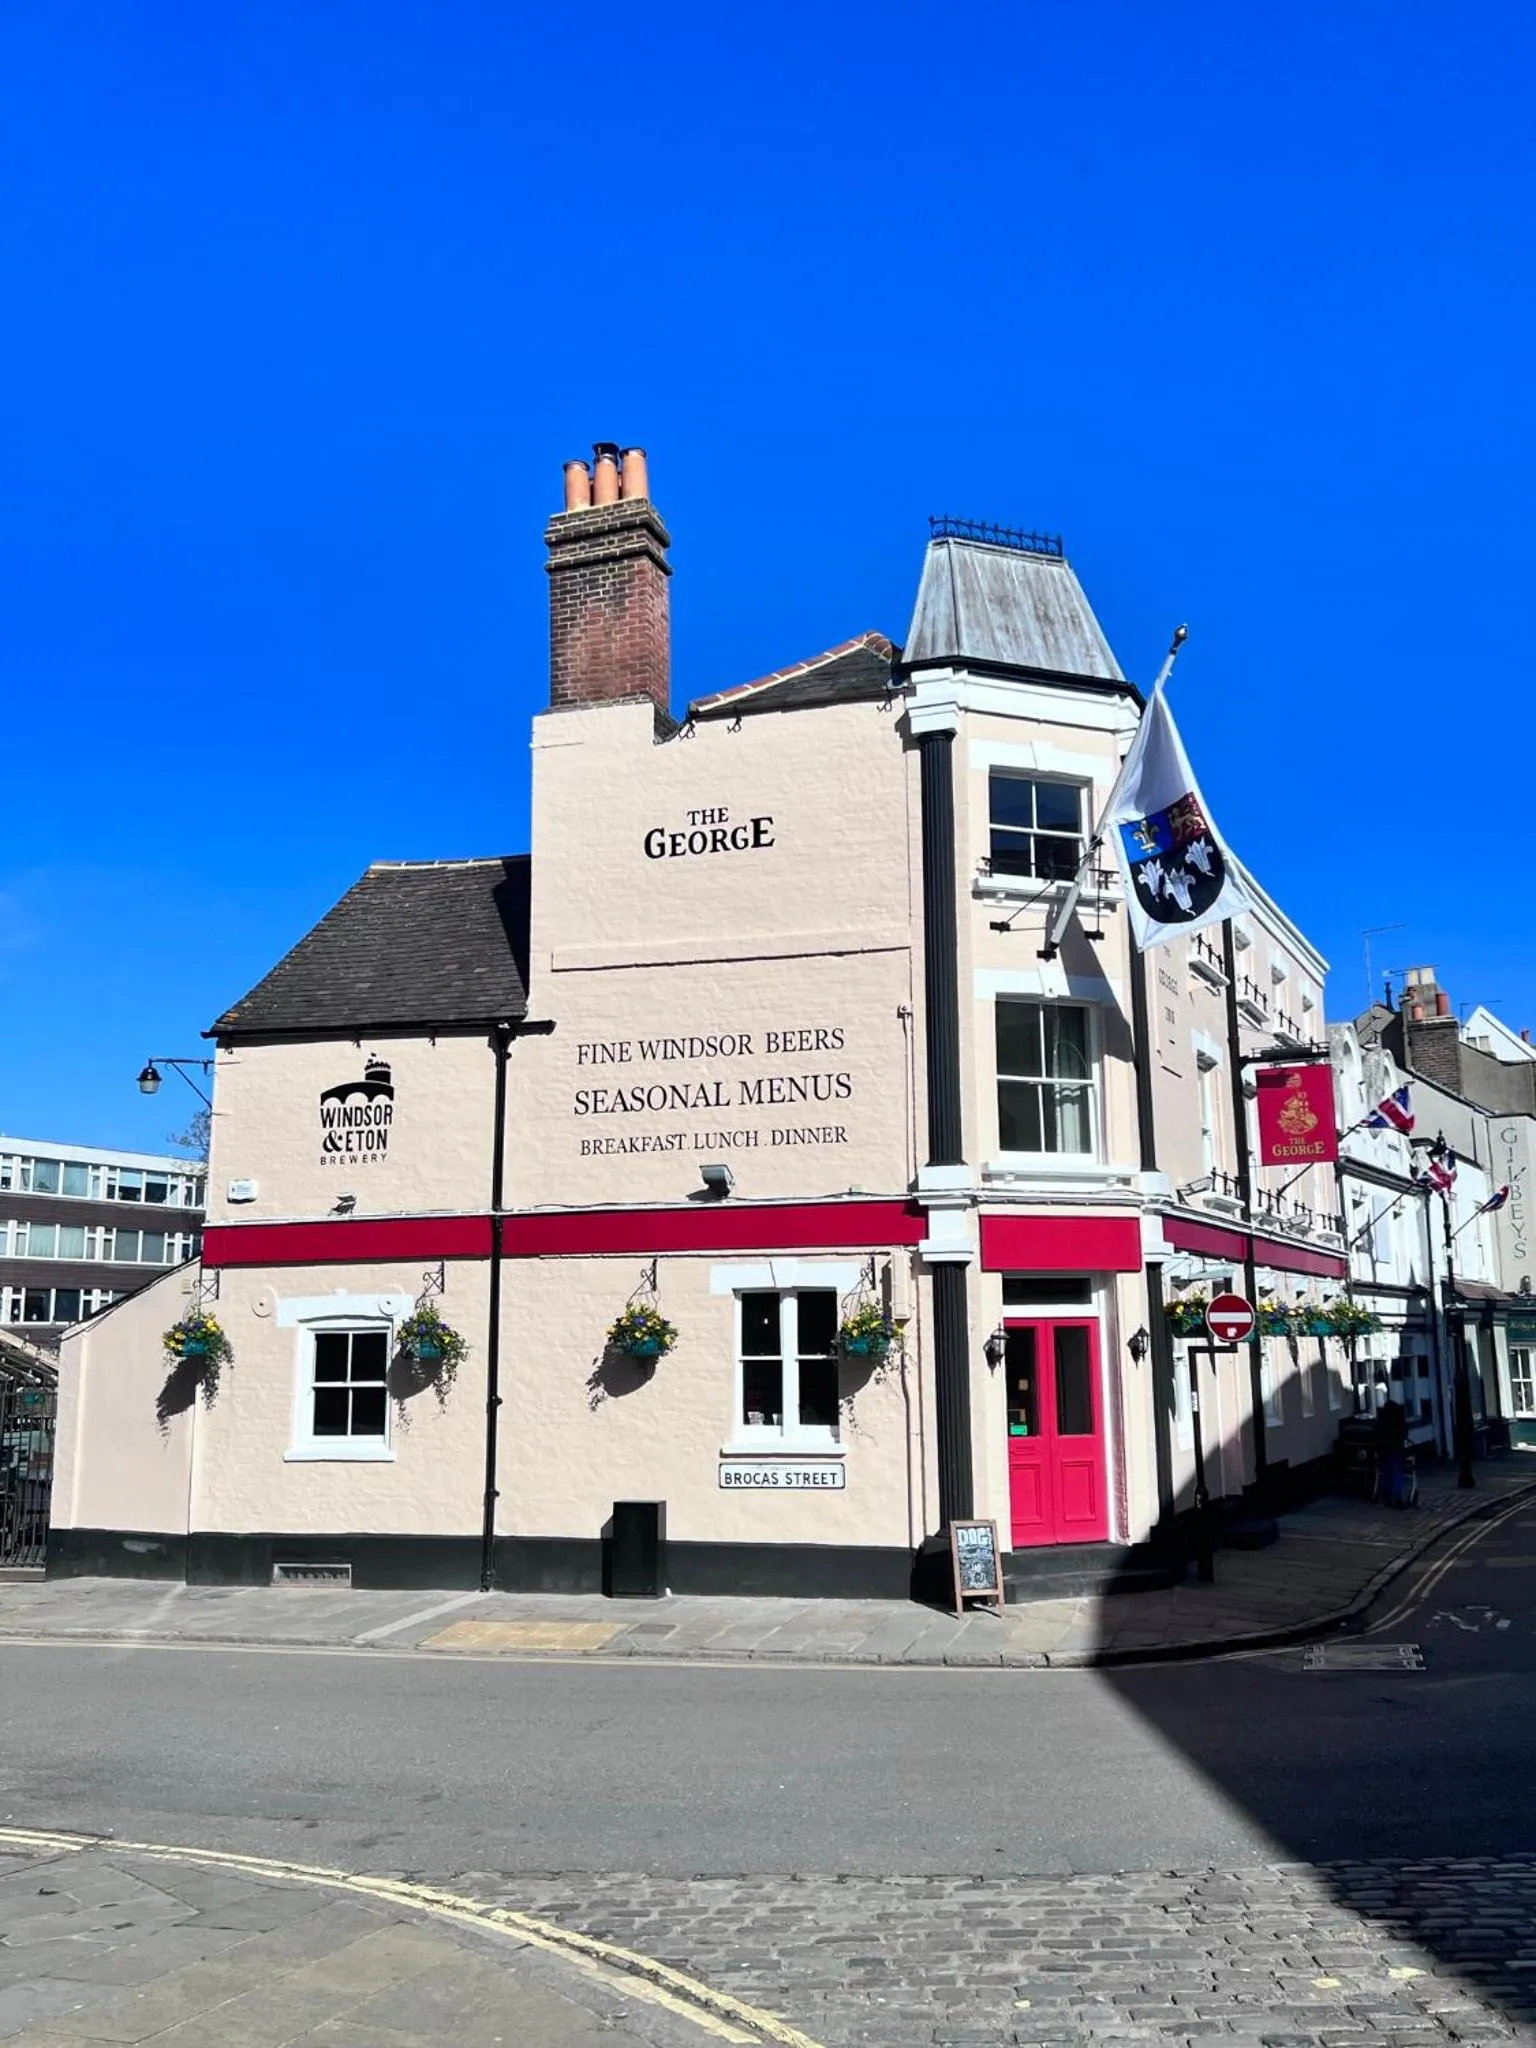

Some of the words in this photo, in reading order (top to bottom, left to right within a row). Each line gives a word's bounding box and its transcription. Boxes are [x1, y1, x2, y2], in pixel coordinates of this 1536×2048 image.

[687, 807, 729, 827] THE
[644, 816, 776, 860] GEORGE
[577, 1041, 633, 1065] FINE
[637, 1034, 754, 1062] WINDSOR
[765, 1027, 845, 1054] BEERS
[573, 1082, 731, 1116] SEASONAL
[738, 1072, 853, 1106] MENUS
[320, 1104, 393, 1128] WINDSOR
[580, 1133, 688, 1156] BREAKFAST
[694, 1130, 760, 1150] LUNCH
[771, 1126, 849, 1146] DINNER
[1272, 1141, 1325, 1156] GEORGE
[320, 1153, 388, 1166] BREWERY
[724, 1472, 779, 1485] BROCAS
[785, 1472, 838, 1485] STREET
